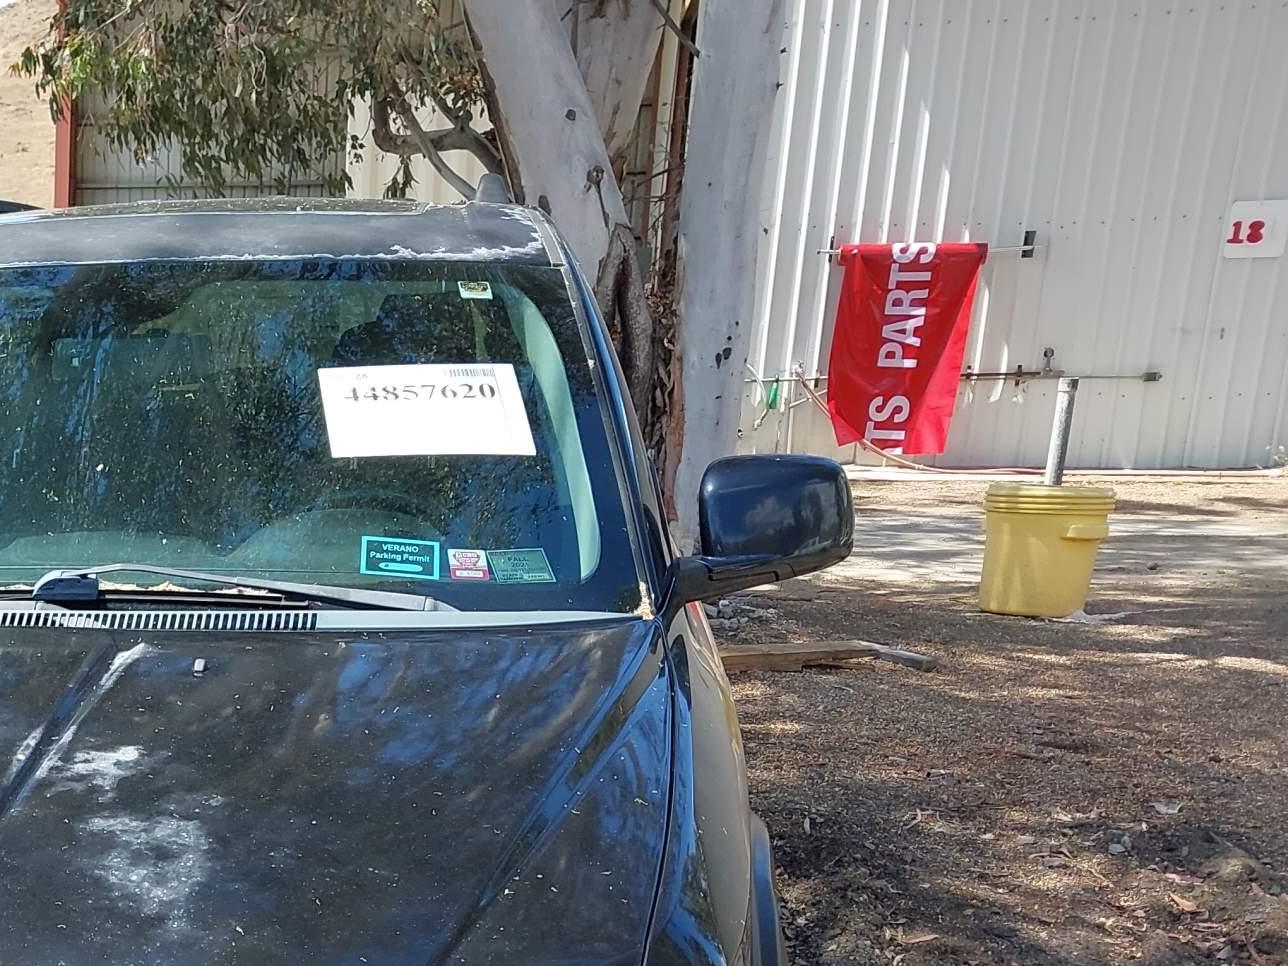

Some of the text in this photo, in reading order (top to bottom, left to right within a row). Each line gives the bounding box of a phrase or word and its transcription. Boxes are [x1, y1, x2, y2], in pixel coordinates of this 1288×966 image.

[1226, 220, 1265, 244] 18
[877, 242, 937, 368] PARTS
[344, 383, 496, 402] 44857620
[369, 551, 430, 563] Parking Permit
[382, 543, 419, 553] VERANO
